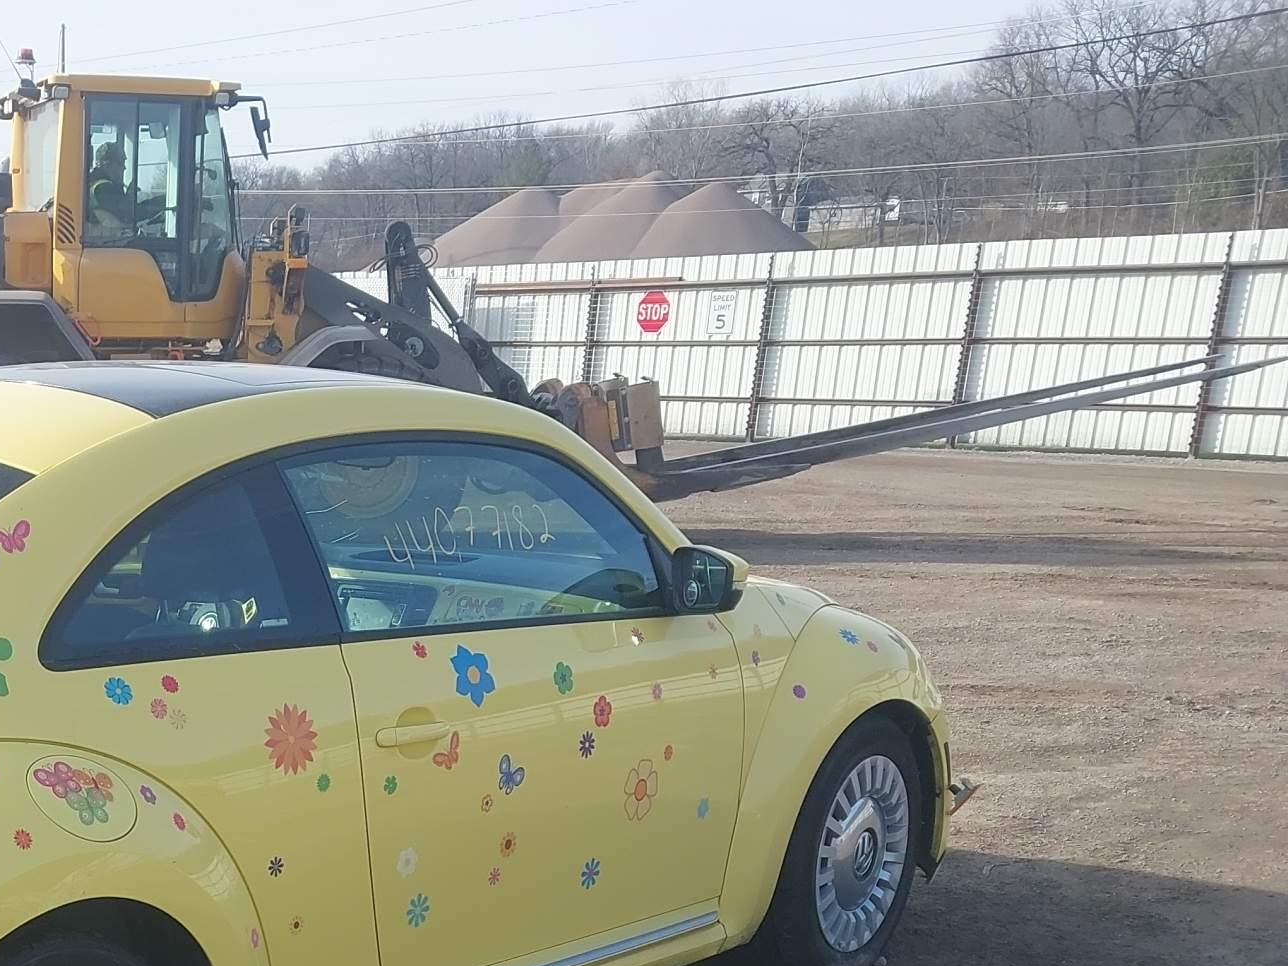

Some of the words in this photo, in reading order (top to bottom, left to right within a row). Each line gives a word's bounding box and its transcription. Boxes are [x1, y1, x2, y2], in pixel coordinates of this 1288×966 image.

[712, 294, 735, 303] SPEED
[638, 303, 669, 321] STOP
[713, 304, 731, 312] LIMIT
[715, 315, 726, 329] 5
[383, 504, 556, 569] 44077182
